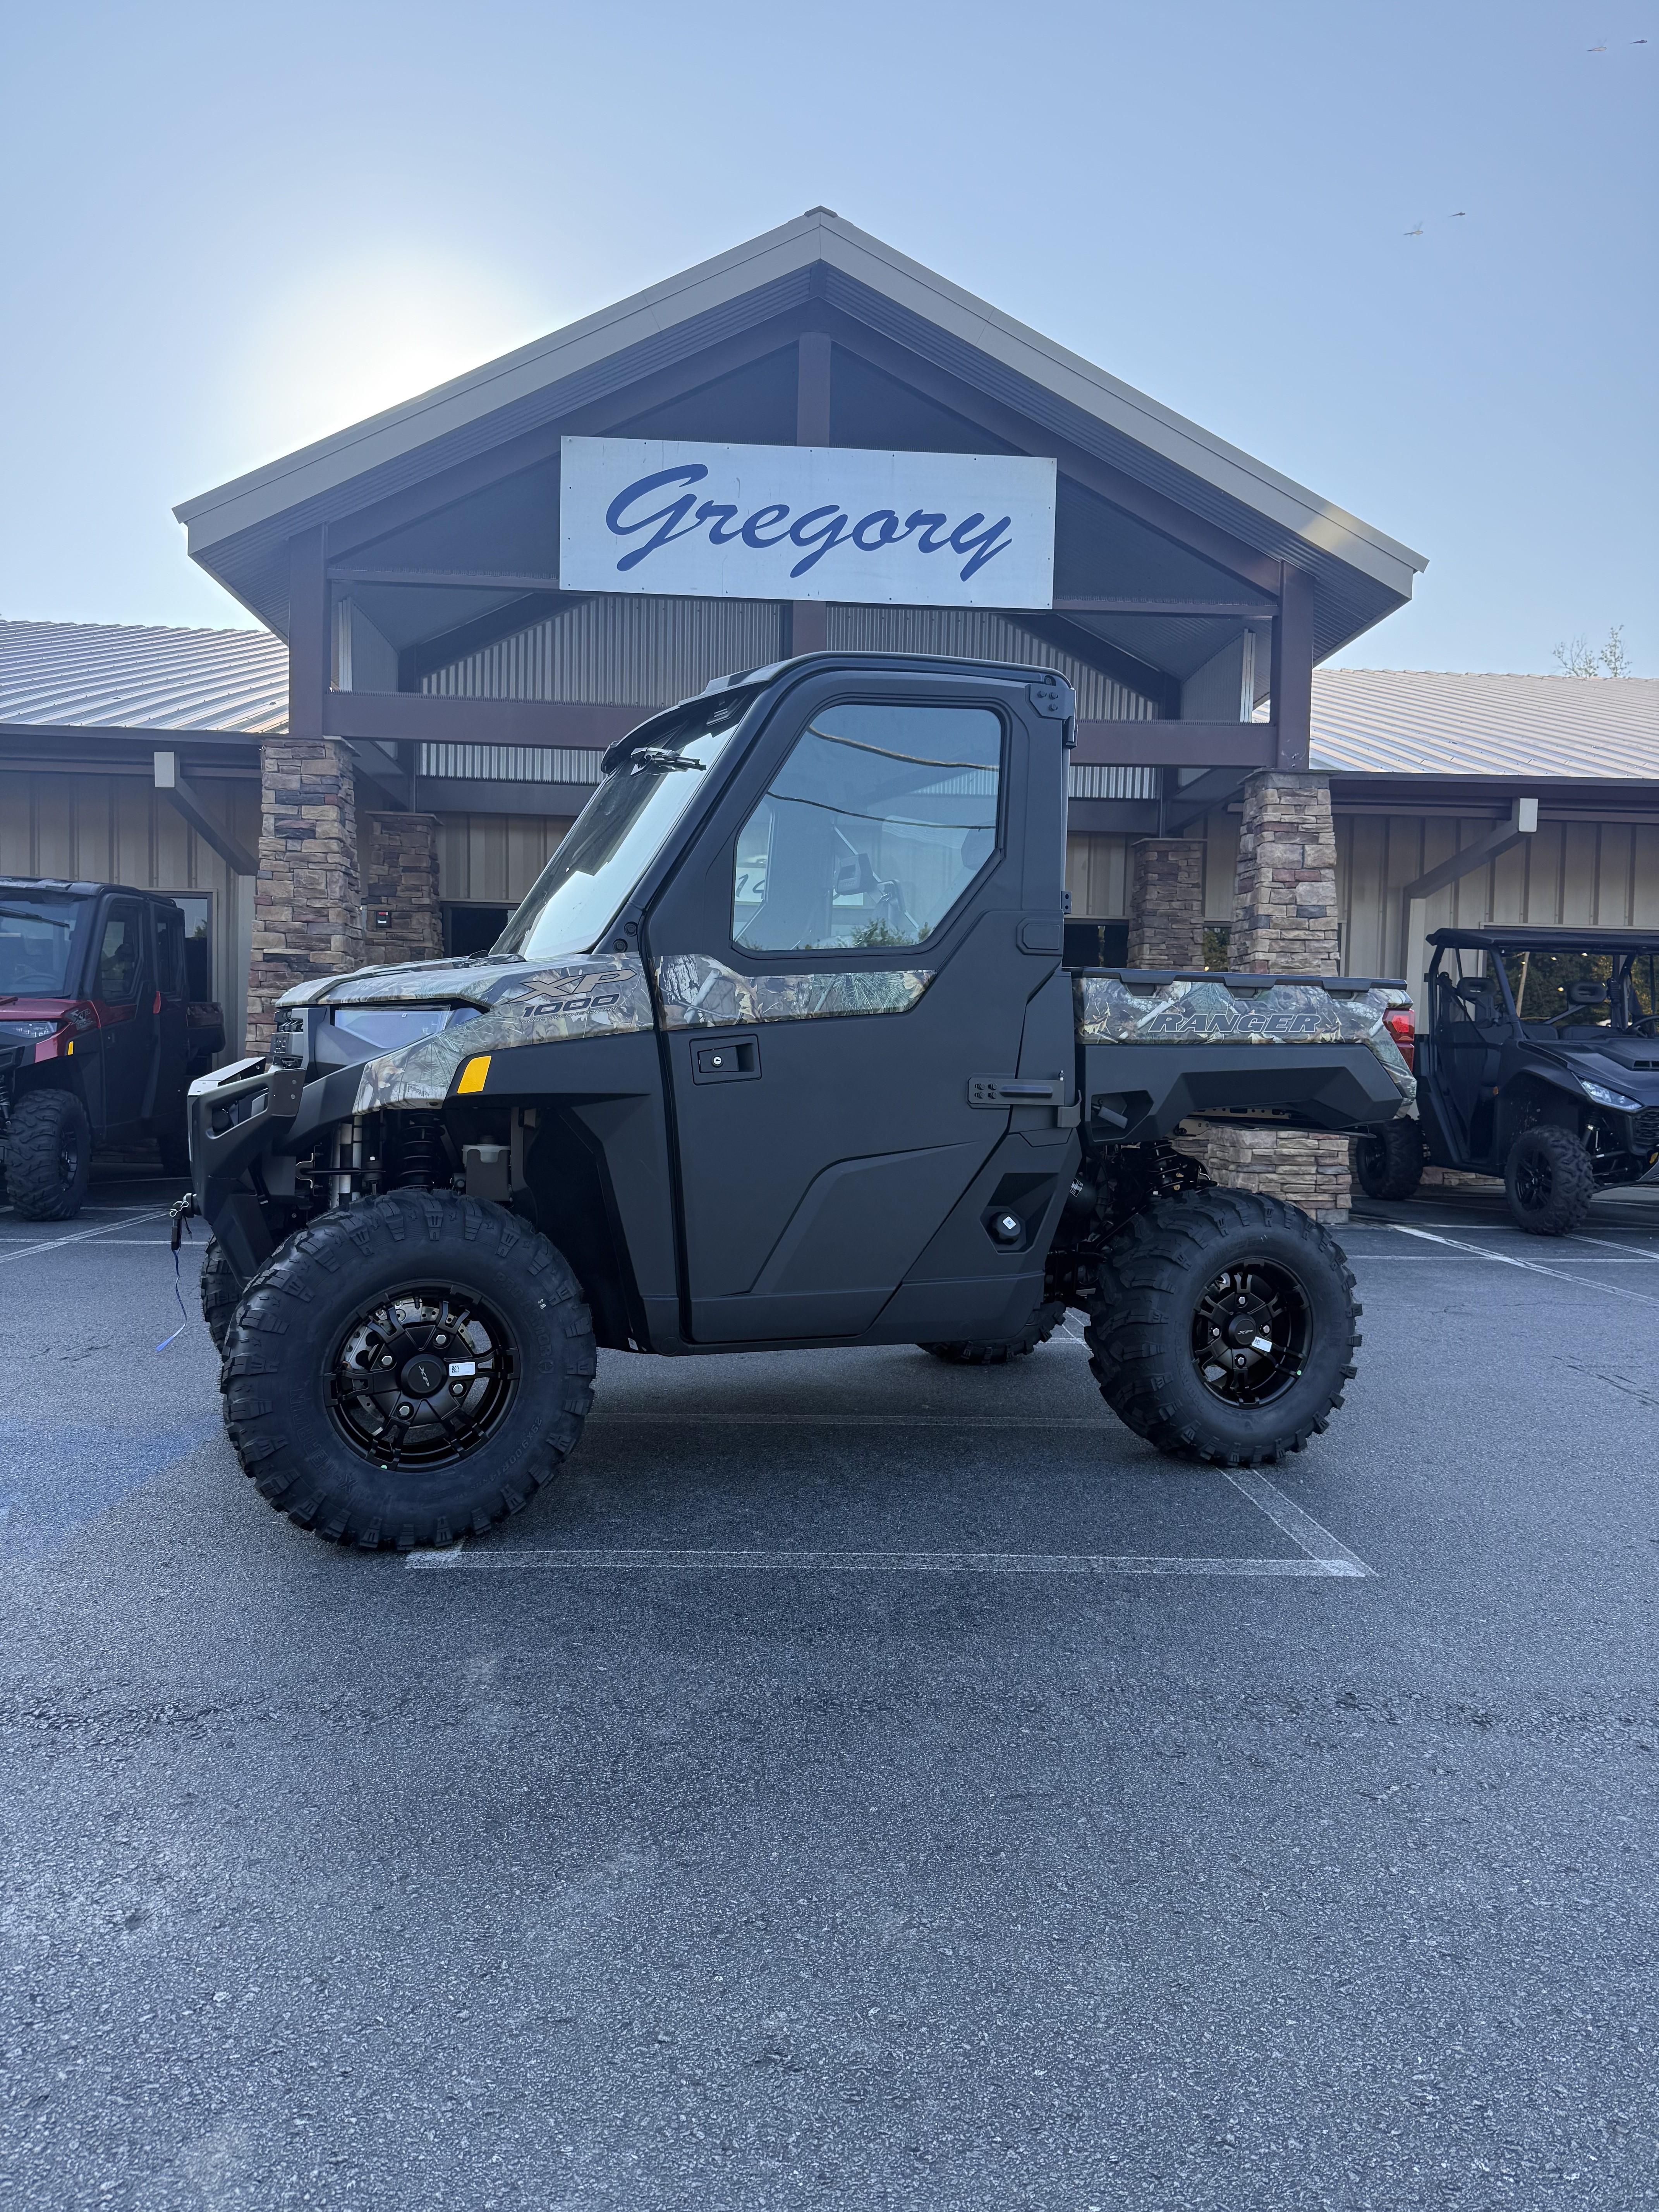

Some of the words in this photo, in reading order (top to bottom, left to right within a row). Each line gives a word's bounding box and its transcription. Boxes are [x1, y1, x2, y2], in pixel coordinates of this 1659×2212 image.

[606, 463, 1012, 582] Gregory
[500, 969, 637, 1005] XP
[522, 993, 620, 1018] 1000
[1148, 1013, 1322, 1033] RANGER
[418, 1365, 430, 1387] XP
